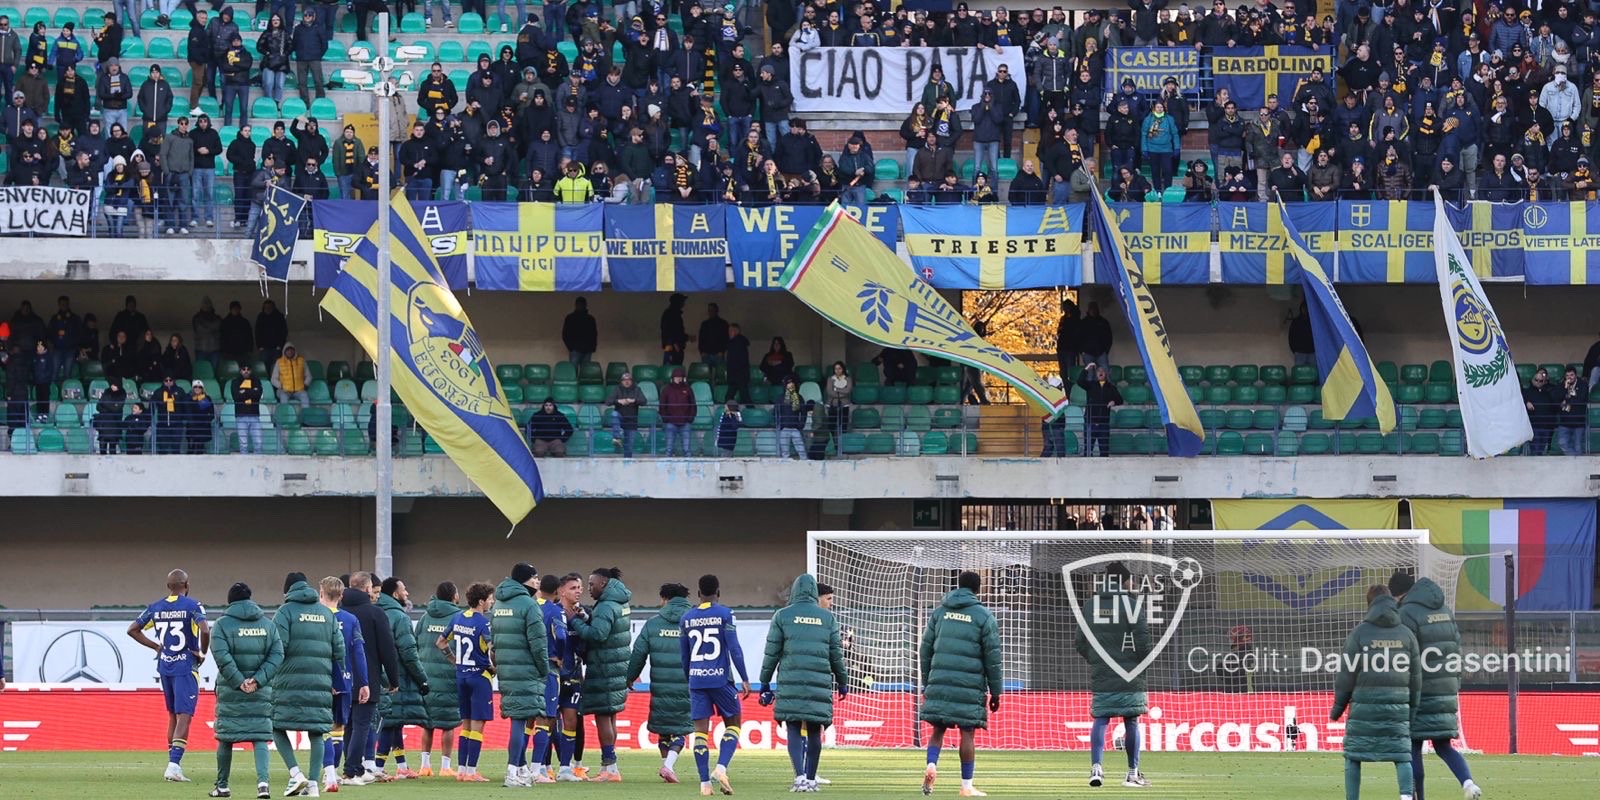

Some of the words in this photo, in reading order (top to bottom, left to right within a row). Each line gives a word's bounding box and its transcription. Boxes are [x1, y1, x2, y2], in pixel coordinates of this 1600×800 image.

[1120, 50, 1197, 67] CASELLE
[1217, 57, 1325, 73] BARDOLINO
[801, 48, 883, 99] CIAO
[1121, 74, 1197, 90] IALLOLU
[738, 206, 795, 233] WE
[474, 234, 600, 253] MANIPOLO
[606, 240, 628, 256] WE
[632, 240, 667, 256] HATE
[671, 239, 726, 255] HUMANS
[931, 238, 1056, 254] TRIESTE
[1351, 232, 1434, 248] SCALIGER
[1460, 231, 1520, 248] UEPOS
[1525, 237, 1568, 248] VIETTE
[440, 350, 476, 387] 1903
[414, 351, 480, 413] VERONA
[155, 621, 186, 652] 73
[688, 628, 721, 662] 25
[454, 634, 476, 666] 12
